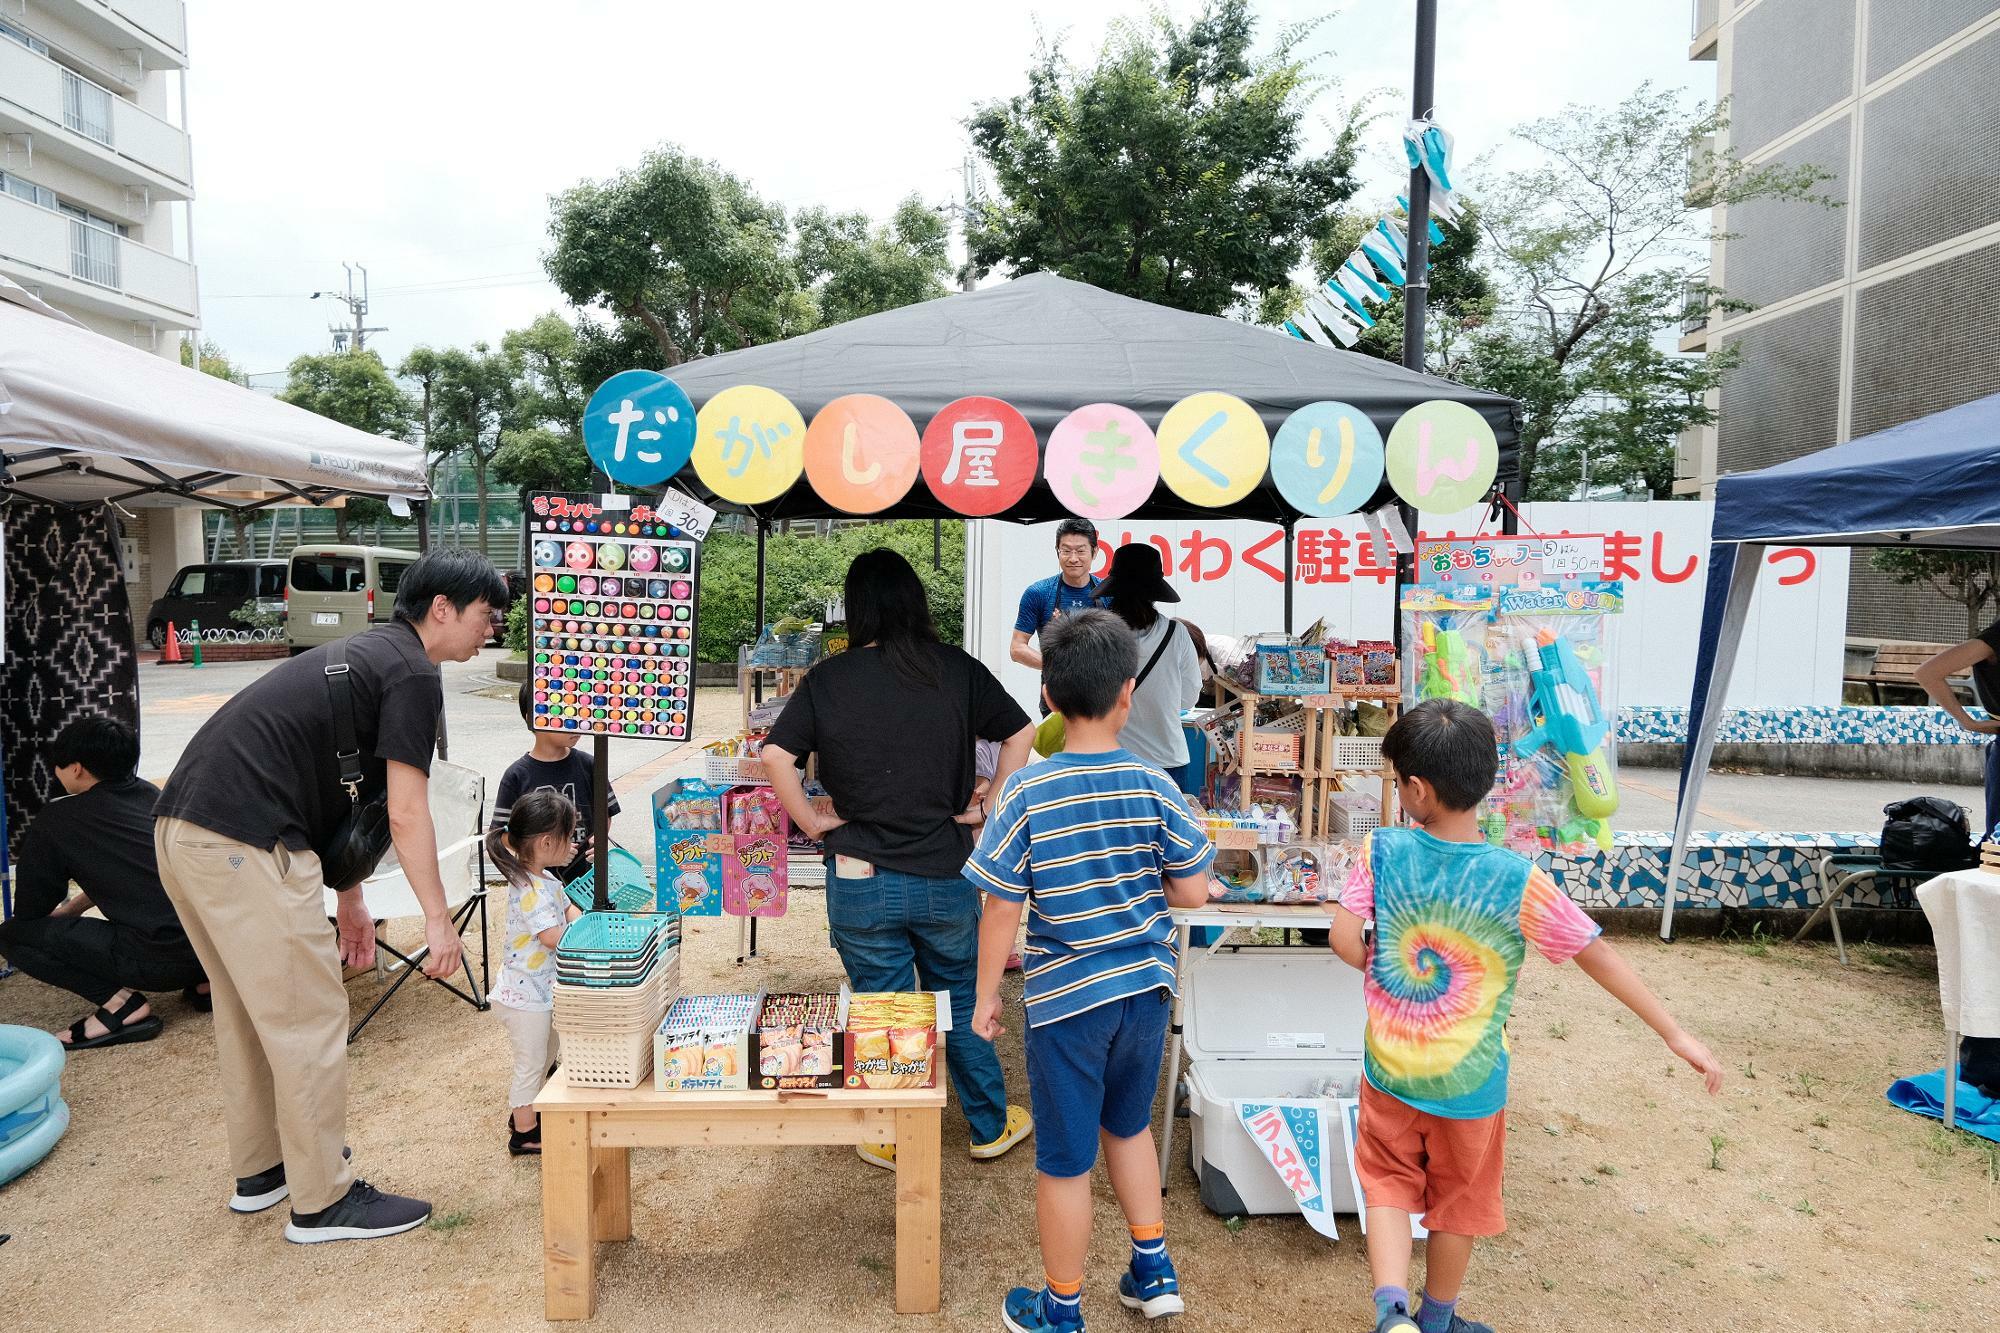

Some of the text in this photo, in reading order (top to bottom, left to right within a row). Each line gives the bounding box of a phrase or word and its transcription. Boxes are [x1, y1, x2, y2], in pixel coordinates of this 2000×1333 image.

[608, 399, 1479, 507] だがし屋きくりん
[549, 497, 602, 518] スーパー
[676, 511, 705, 538] 30円
[1508, 591, 1616, 610] Water Gun
[671, 844, 707, 864] ソフト
[739, 850, 774, 867] ソフト
[681, 1079, 722, 1090] ポテトフライ
